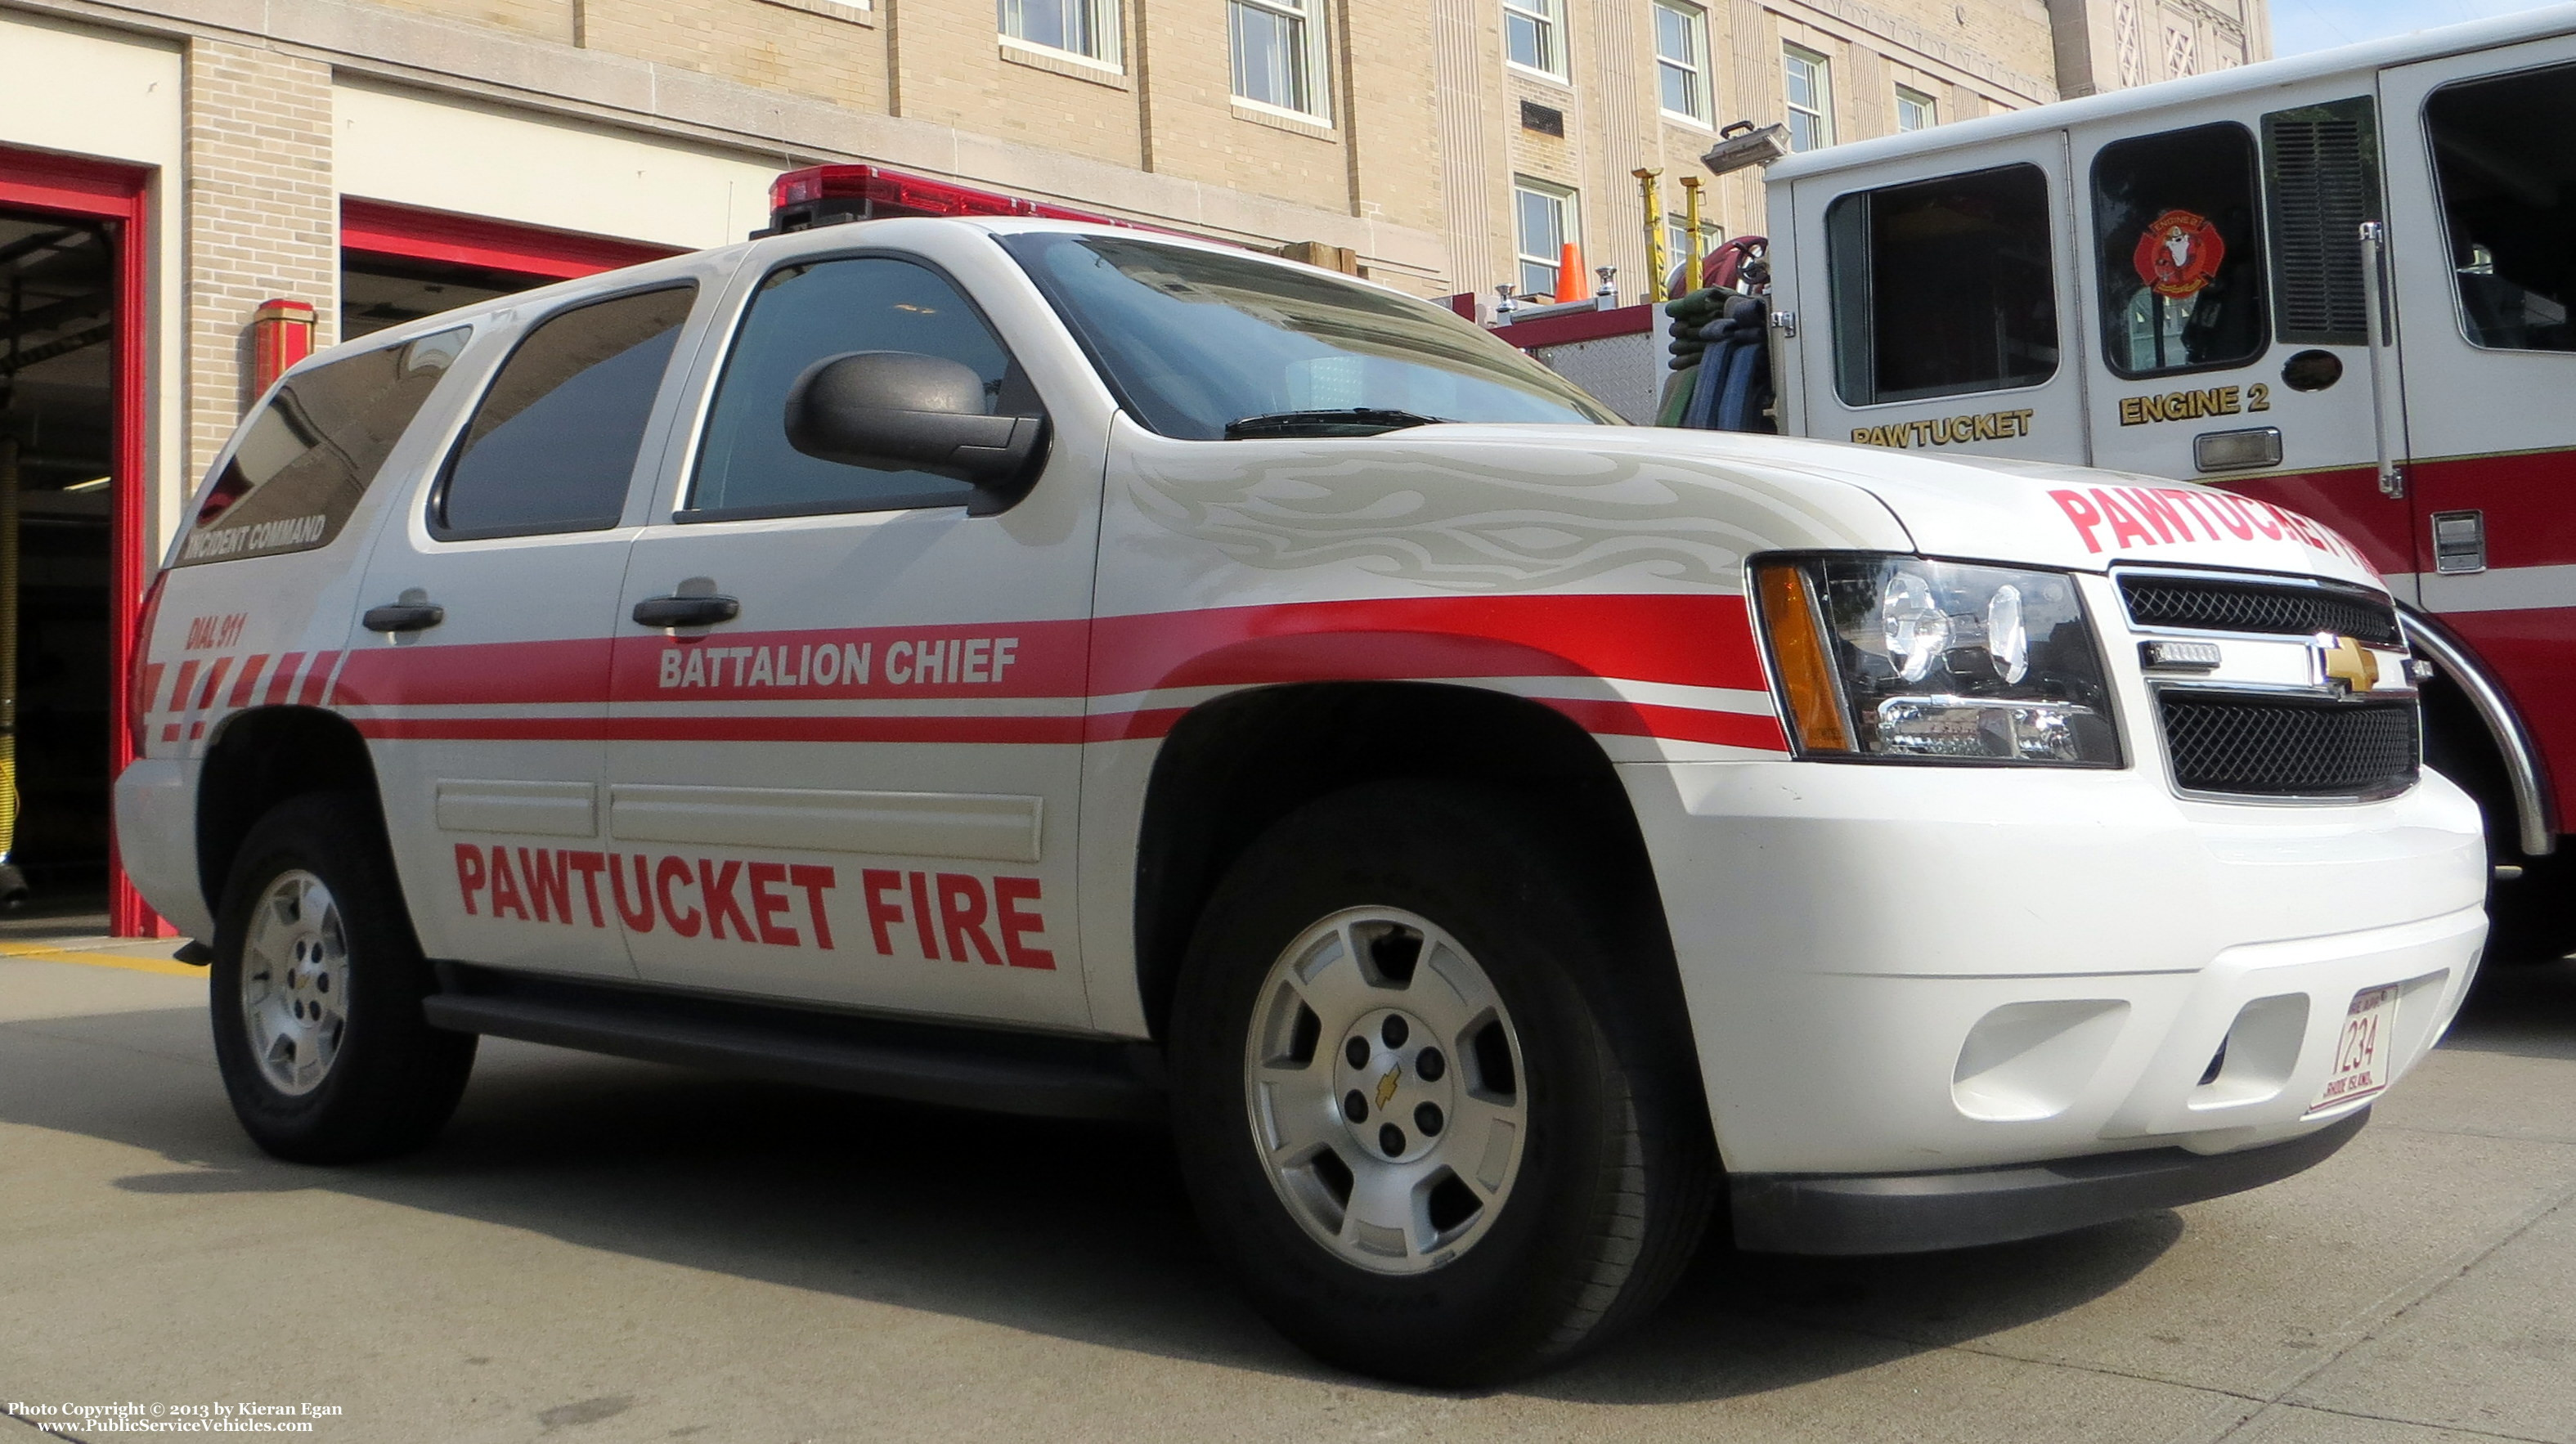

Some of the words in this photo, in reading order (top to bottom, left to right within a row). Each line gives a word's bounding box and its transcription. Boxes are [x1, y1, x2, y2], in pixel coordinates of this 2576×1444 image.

[2154, 216, 2189, 230] ENGINE
[2120, 385, 2241, 426] ENGINE
[2247, 383, 2270, 412] 2
[1851, 409, 2033, 448] PAWTUCKET
[184, 526, 250, 560] INCIDENT
[249, 514, 326, 550] COMMAND
[184, 615, 219, 650] DIAL
[216, 612, 249, 648] 911
[659, 642, 872, 688] BATTALION
[885, 637, 1020, 685] CHIEF
[454, 843, 835, 950] PAWTUCKET
[862, 868, 1057, 971] FIRE
[2341, 1014, 2378, 1072] 234
